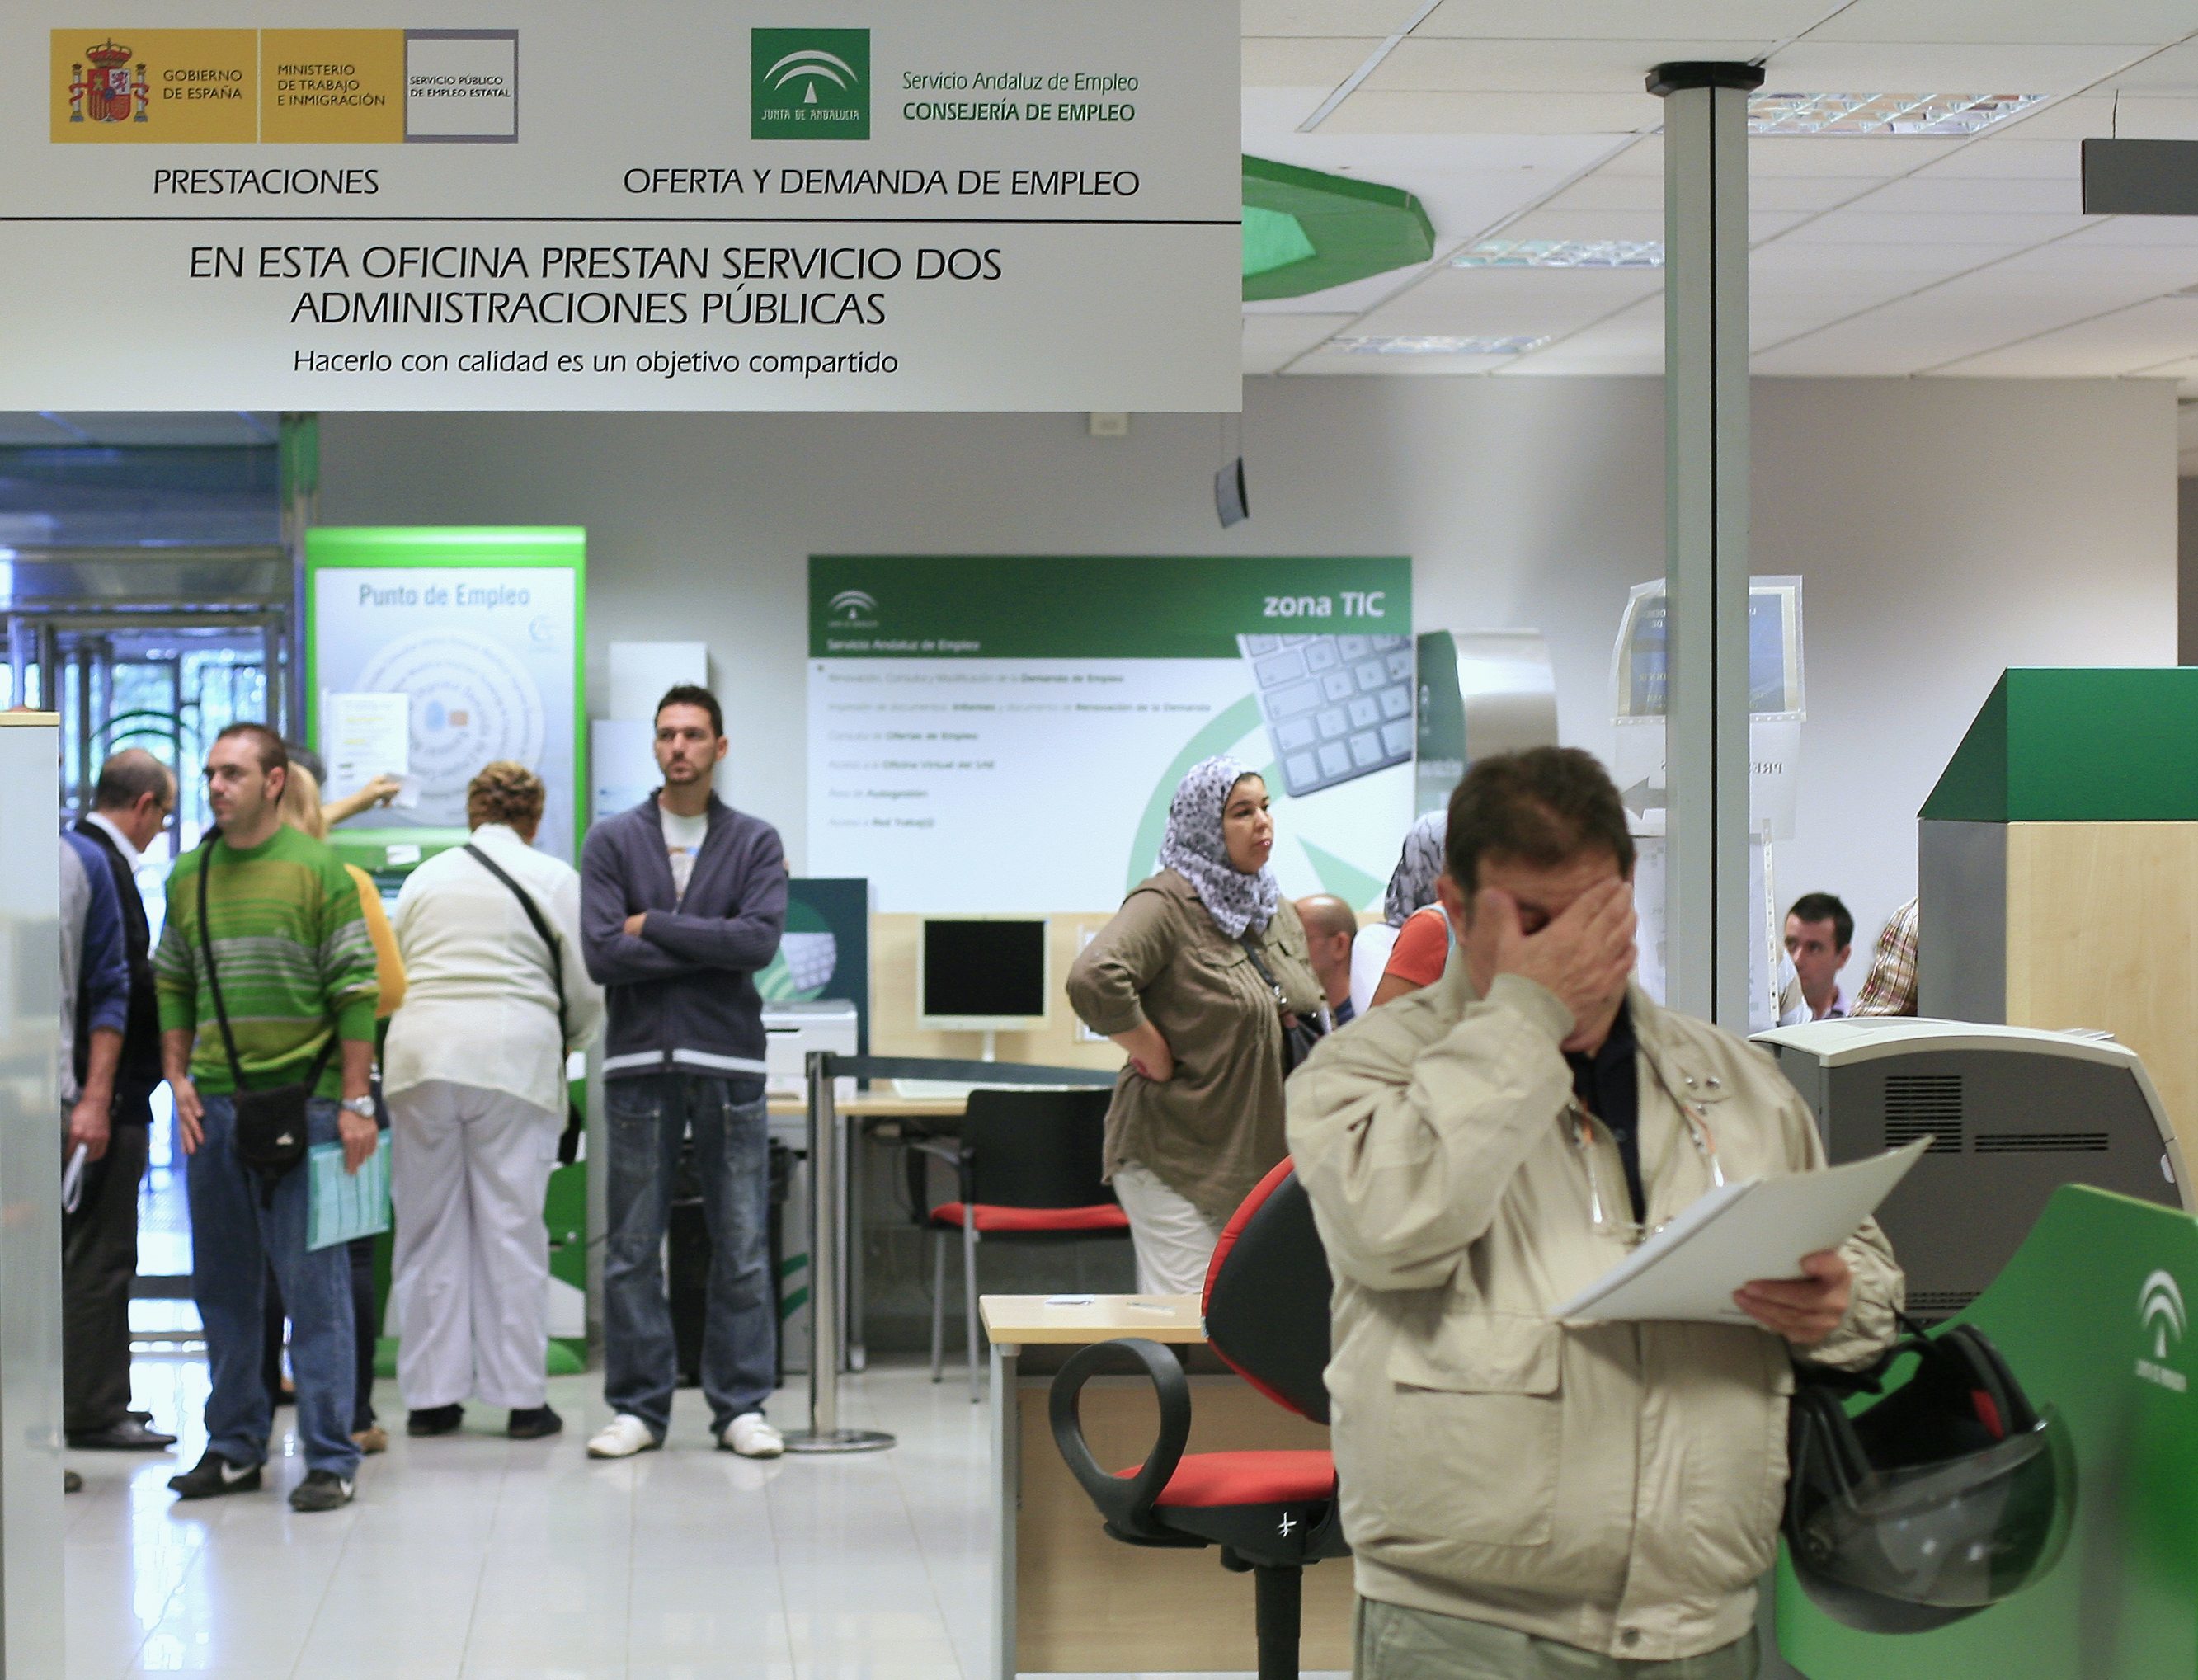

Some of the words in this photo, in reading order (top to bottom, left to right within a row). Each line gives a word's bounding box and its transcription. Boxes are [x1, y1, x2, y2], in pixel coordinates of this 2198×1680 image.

[163, 70, 242, 82] GOBIERNO
[277, 64, 355, 76] MINISTERIO
[410, 76, 456, 85] SERVICIO
[459, 73, 503, 85] PÚBLICO
[163, 88, 182, 99] DE
[187, 85, 242, 100] ESPAÑA
[277, 79, 295, 91] DE
[298, 79, 360, 92] TRABAJO
[410, 89, 423, 97] DE
[426, 89, 467, 97] EMPLEO
[469, 89, 511, 97] ESTATAL
[902, 72, 967, 90] Servicio
[972, 72, 1043, 90] Andaluz
[1047, 72, 1070, 90] de
[1074, 73, 1139, 96] Empleo
[277, 95, 285, 106] E
[289, 92, 385, 106] INMIGRACIÓN
[902, 97, 1020, 121] CONSEJERÍA
[1025, 103, 1052, 121] DE
[1057, 103, 1136, 122] EMPLEO
[761, 109, 791, 120] JUNTA
[794, 109, 806, 120] DE
[153, 168, 379, 195] PRESTACIONES
[624, 167, 744, 194] OFERTA
[752, 168, 771, 194] Y
[780, 168, 948, 195] DEMANDA
[958, 169, 1001, 195] DE
[1011, 170, 1140, 196] EMPLEO
[190, 247, 244, 278] EN
[259, 247, 350, 279] ESTA
[362, 246, 529, 279] OFICINA
[542, 247, 708, 279] PRESTAN
[722, 247, 901, 280] SERVICIO
[916, 247, 1002, 280] DOS
[290, 291, 688, 325] ADMINISTRACIONES
[700, 281, 887, 325] PÚBLICAS
[294, 350, 392, 372] Hacerlo
[401, 355, 449, 372] con
[458, 350, 548, 372] calidad
[558, 355, 584, 373] es
[593, 355, 626, 373] un
[636, 350, 740, 379] objetivo
[749, 351, 898, 379] compartido
[358, 583, 418, 607] Punto
[424, 583, 448, 607] de
[456, 583, 531, 609] Empleo
[1264, 596, 1332, 617] zona
[1340, 591, 1385, 618] TIC
